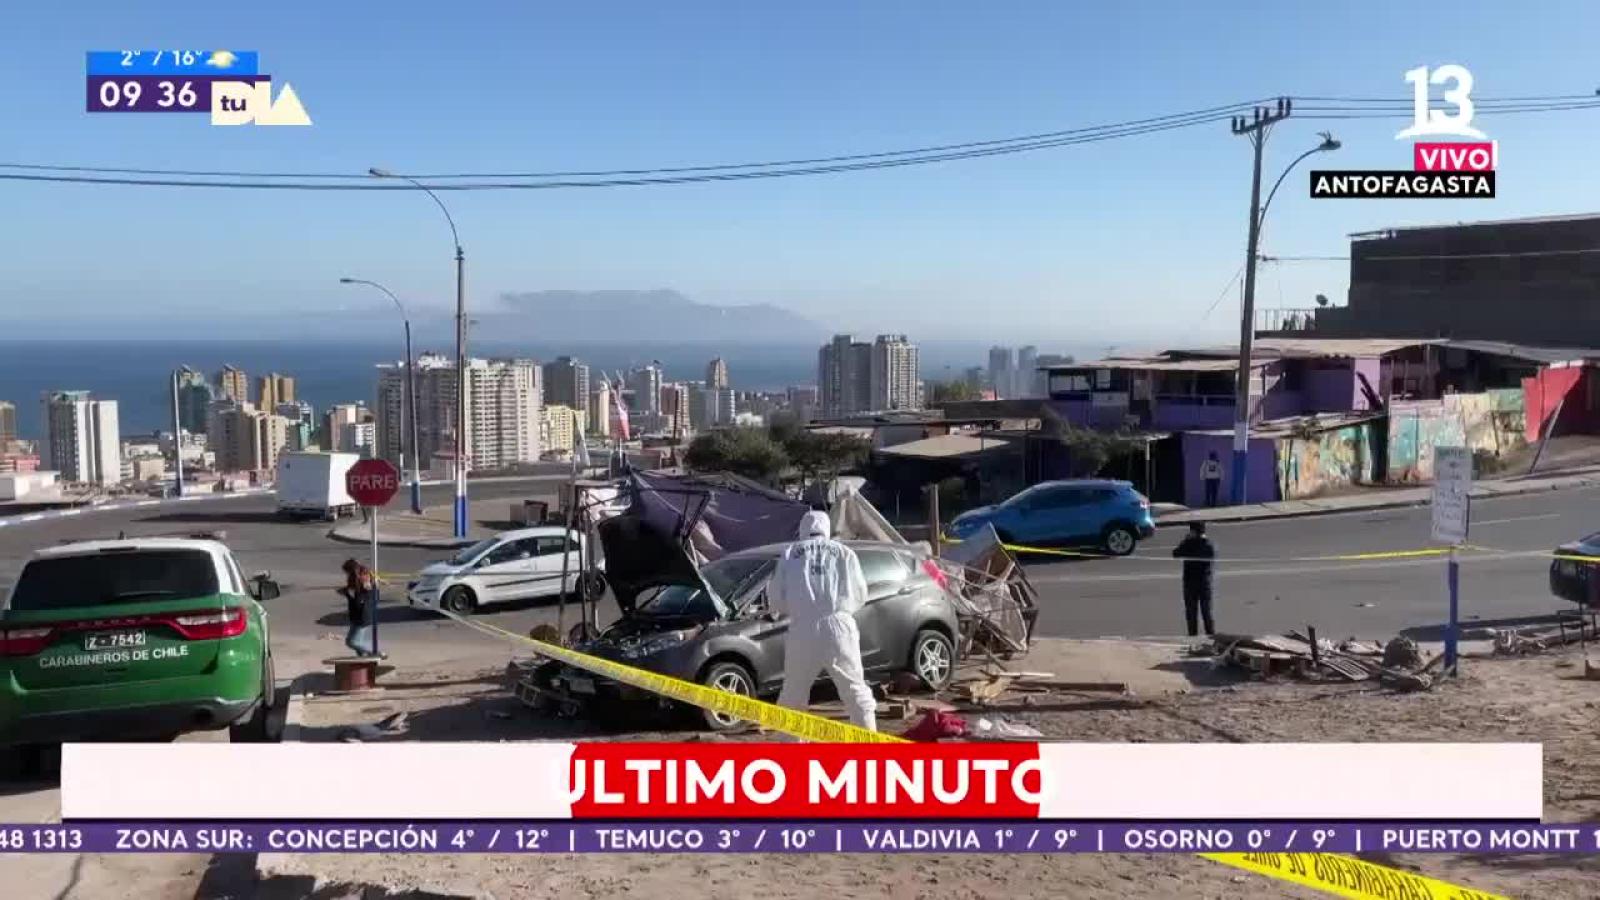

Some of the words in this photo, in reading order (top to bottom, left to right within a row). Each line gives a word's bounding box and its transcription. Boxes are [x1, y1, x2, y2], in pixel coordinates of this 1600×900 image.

[350, 473, 395, 491] PARE
[39, 648, 129, 669] CARABINEROS
[132, 648, 149, 662] DE
[153, 644, 190, 660] CHILE
